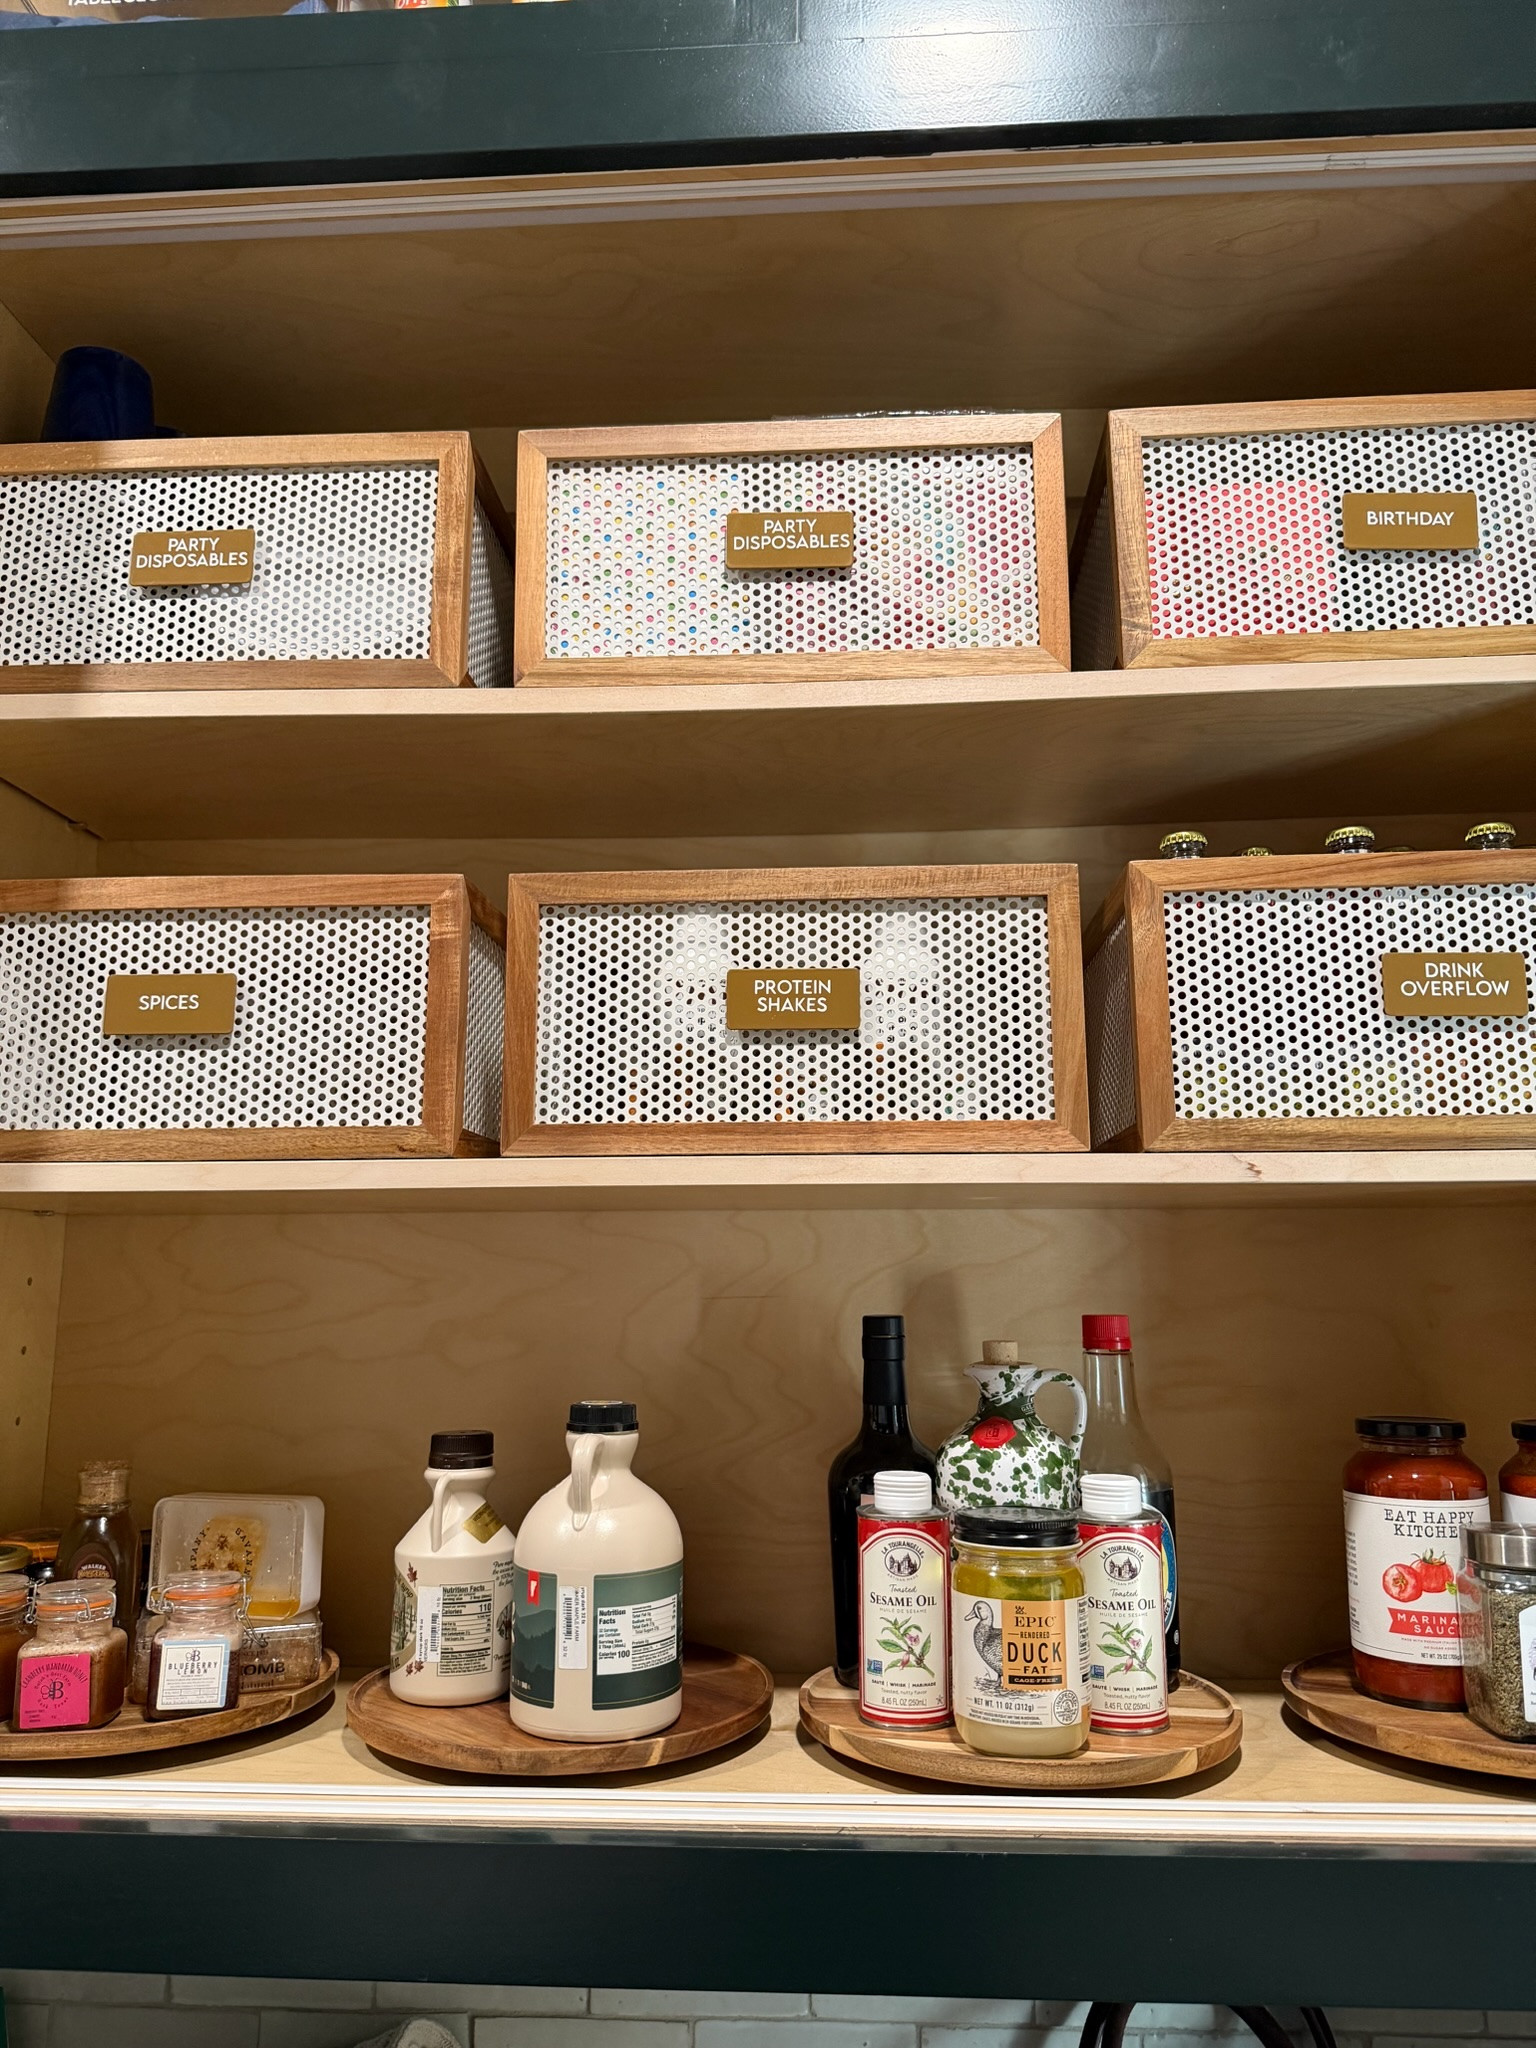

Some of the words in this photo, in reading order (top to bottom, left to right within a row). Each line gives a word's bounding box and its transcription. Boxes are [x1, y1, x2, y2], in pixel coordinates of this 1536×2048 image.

[1366, 511, 1454, 526] BIRTHDAY
[764, 519, 817, 534] PARTY
[168, 537, 220, 552] PARTY
[733, 533, 850, 550] DISPOSABLES
[135, 551, 248, 569] DISPOSABLES
[1424, 962, 1484, 978] DRINK
[754, 979, 831, 995] PROTEIN
[1400, 980, 1510, 997] OVERFLOW
[138, 994, 200, 1011] SPICES
[757, 996, 828, 1013] SHAKES
[1384, 1508, 1417, 1523] EAT
[1423, 1511, 1474, 1524] HAPPY
[1393, 1523, 1458, 1538] KITCHE
[881, 1546, 889, 1555] LA
[1100, 1552, 1108, 1560] LA
[1107, 1545, 1145, 1561] TOURANGELLE
[81, 1563, 107, 1571] WALKER
[442, 1586, 468, 1594] Nutrition
[889, 1583, 918, 1593] Toasted
[1109, 1588, 1138, 1598] Toasted
[869, 1591, 913, 1607] SESAME
[916, 1594, 937, 1607] OIL
[1087, 1596, 1134, 1611] SESAME
[1137, 1598, 1156, 1611] OIL
[479, 1603, 491, 1612] 110
[598, 1609, 626, 1617] Nutrition
[598, 1617, 616, 1625] Facts
[1014, 1616, 1054, 1628] EPIC
[1397, 1613, 1458, 1625] MARINA
[1020, 1631, 1050, 1639] RENDERED
[1413, 1624, 1456, 1635] SAUC
[617, 1650, 631, 1659] 100
[1007, 1641, 1062, 1663] DUCK
[168, 1662, 218, 1670] BLUEBERRY
[241, 1661, 285, 1676] OMB
[1023, 1665, 1048, 1674] FAT
[881, 1696, 892, 1705] 8.45
[893, 1697, 898, 1705] FL
[900, 1698, 907, 1706] OZ
[973, 1696, 983, 1706] NET
[985, 1699, 994, 1708] WT.
[996, 1701, 1003, 1709] 11
[1004, 1702, 1012, 1710] OZ
[1014, 1702, 1034, 1712] (312g)
[1104, 1701, 1116, 1710] 8.45
[1116, 1702, 1122, 1710] FL
[1123, 1702, 1131, 1710] OZ
